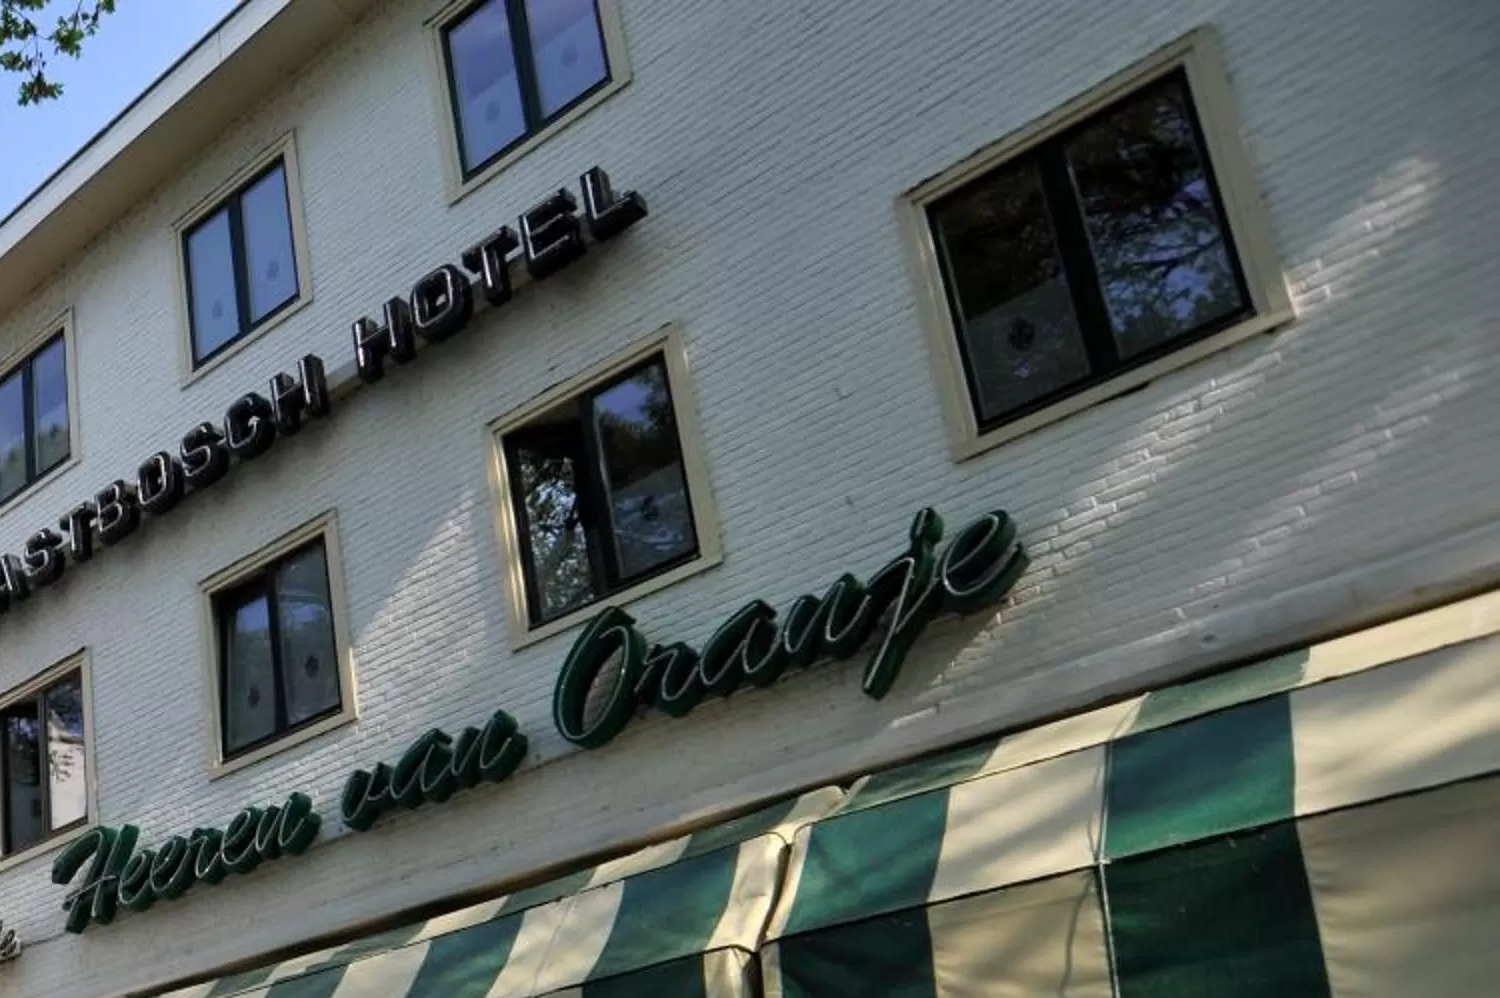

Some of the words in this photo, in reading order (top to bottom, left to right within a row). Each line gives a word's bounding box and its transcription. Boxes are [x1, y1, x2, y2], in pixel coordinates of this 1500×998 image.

[351, 165, 649, 384] HOTEL
[51, 791, 322, 934] Heeren
[340, 709, 529, 832] van
[553, 506, 1032, 749] Oranje
